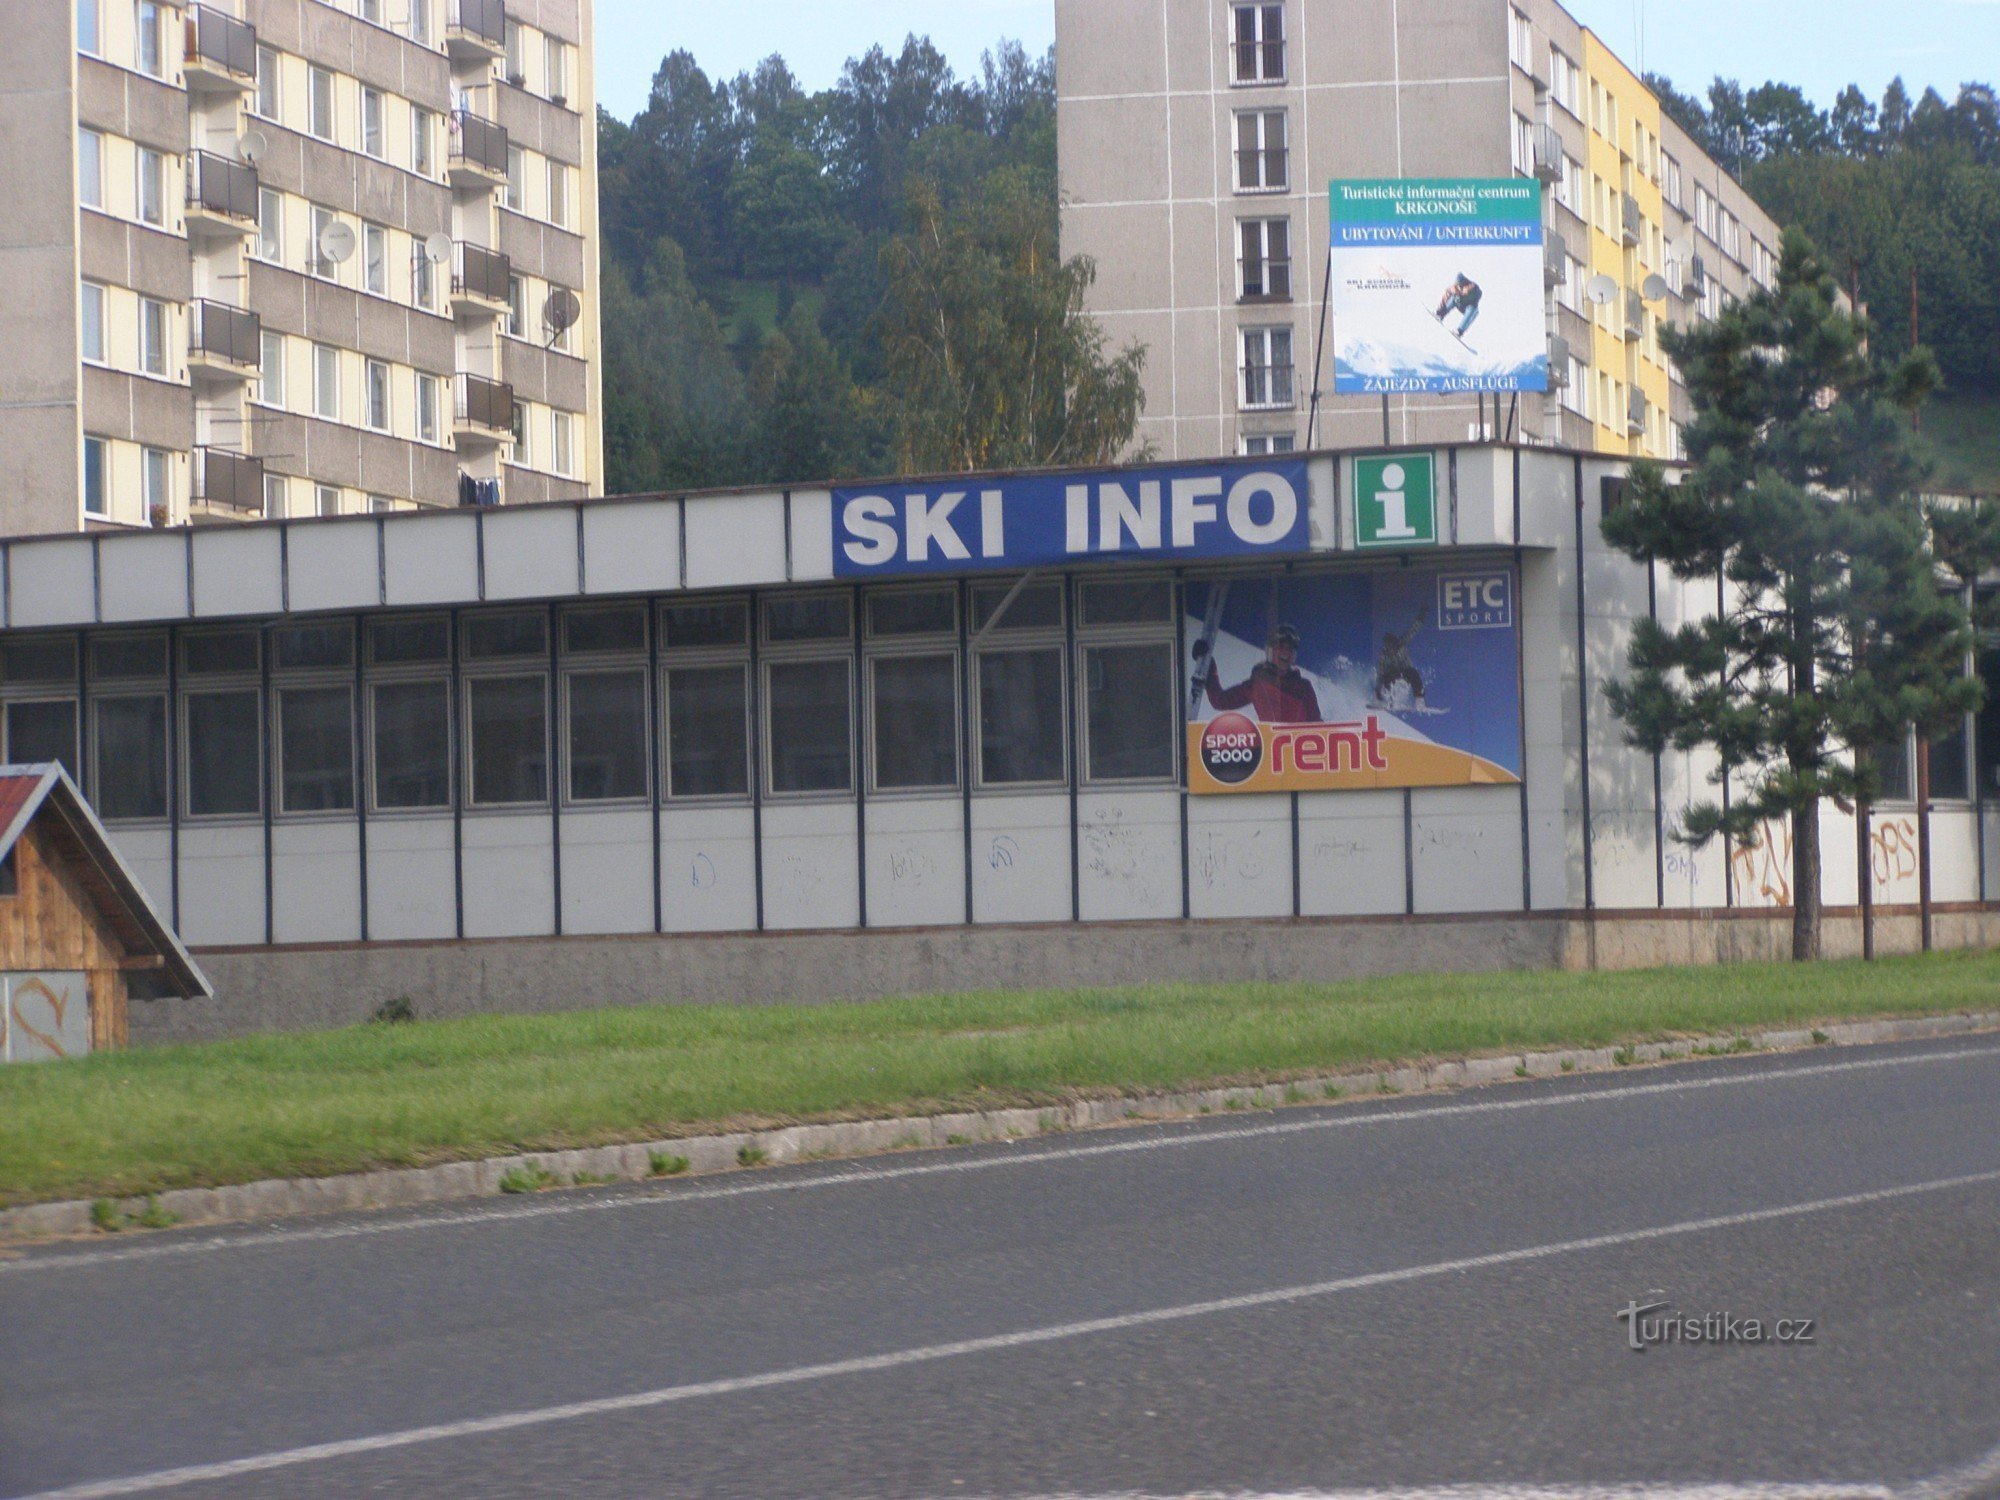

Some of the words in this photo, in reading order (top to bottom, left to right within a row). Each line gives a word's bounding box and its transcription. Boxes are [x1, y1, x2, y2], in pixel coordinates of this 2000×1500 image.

[1341, 185, 1403, 200] Turistické
[1407, 184, 1475, 199] informační
[1478, 186, 1530, 199] centrum
[1395, 199, 1478, 215] KRKONOŠE
[1436, 226, 1531, 240] UNTERKUNFT
[1442, 374, 1518, 390] AUSFLÜGE
[843, 489, 1004, 566] SKI
[1065, 471, 1297, 552] INFO
[1445, 579, 1504, 609] ETC
[1446, 611, 1502, 625] SPORT
[1206, 733, 1257, 748] SPORT
[1271, 715, 1387, 774] rent
[1211, 750, 1253, 763] 2000
